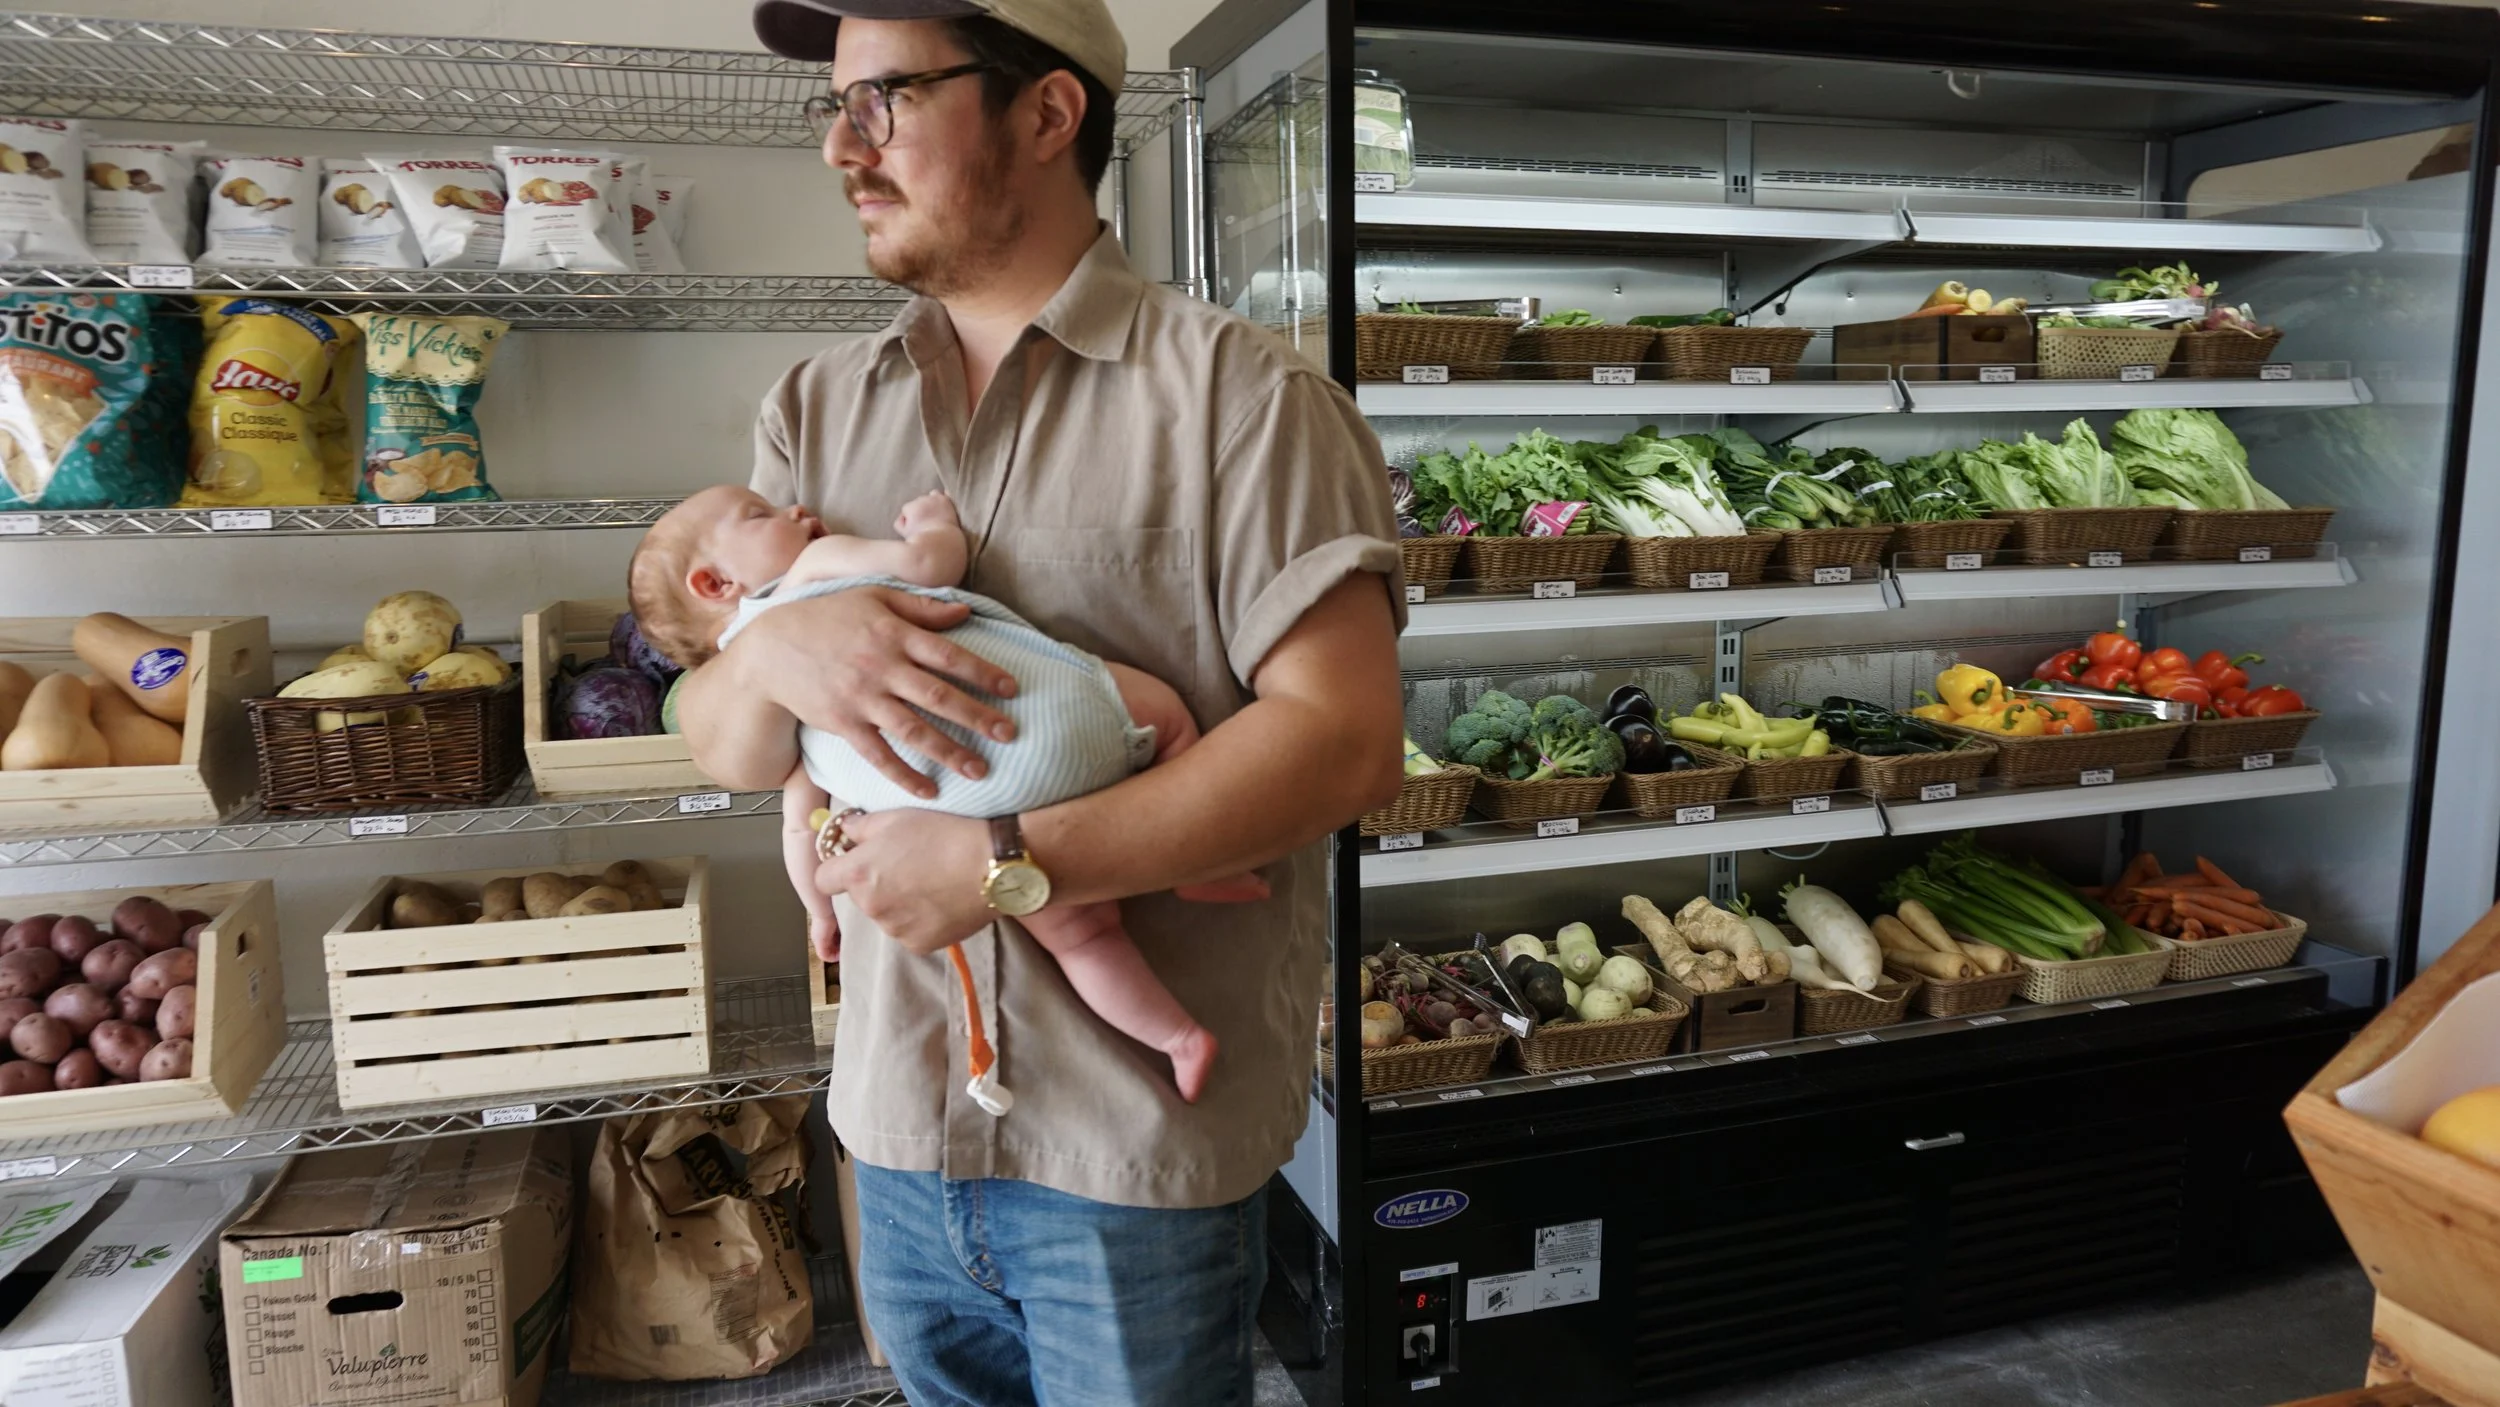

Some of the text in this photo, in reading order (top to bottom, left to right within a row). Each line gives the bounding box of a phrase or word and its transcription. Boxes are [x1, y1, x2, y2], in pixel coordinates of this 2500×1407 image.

[398, 160, 485, 172] TORRES
[510, 156, 600, 166] TORRES
[231, 412, 288, 426] Classic
[222, 427, 300, 444] Classique
[1386, 1194, 1457, 1219] NELLA
[403, 1235, 418, 1245] 50
[421, 1233, 433, 1244] lb
[242, 1242, 330, 1262] Canada No.1
[443, 1239, 491, 1255] NET WT.
[437, 1277, 449, 1287] 10
[263, 1292, 317, 1306] Yukon Gold
[464, 1289, 477, 1300] 70
[466, 1320, 479, 1331] 90
[463, 1336, 481, 1348] 100
[265, 1343, 305, 1355] Blanche
[469, 1352, 482, 1363] 50
[326, 1352, 429, 1378] Valupierre
